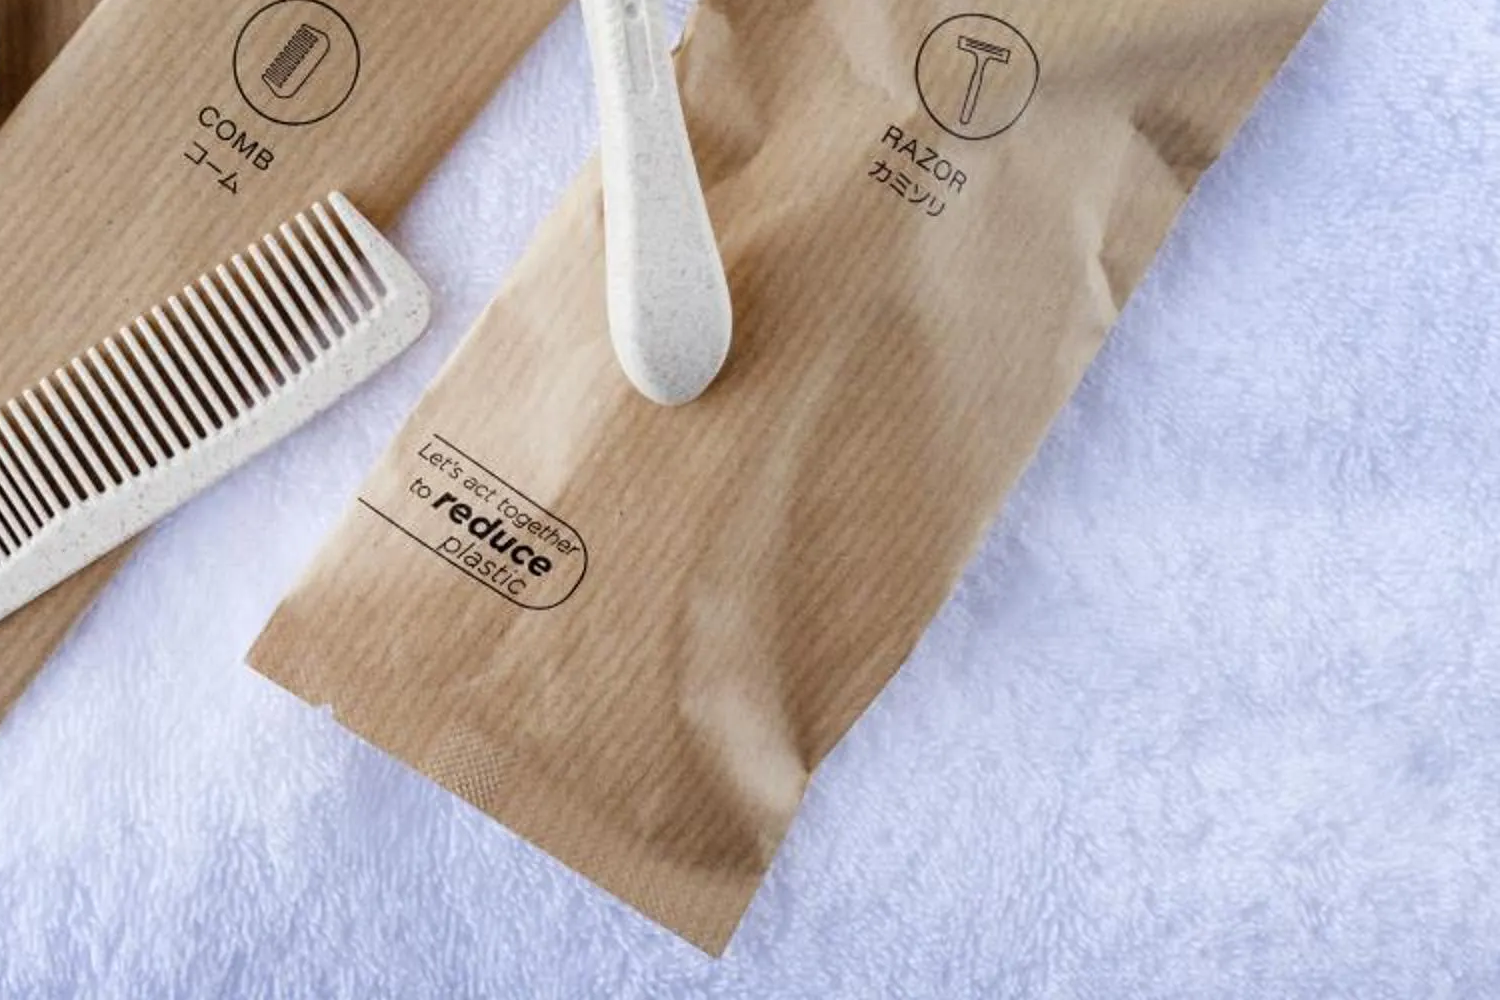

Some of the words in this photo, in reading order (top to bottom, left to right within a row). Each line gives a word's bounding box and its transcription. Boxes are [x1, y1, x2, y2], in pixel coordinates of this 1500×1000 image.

[184, 141, 238, 194] コーム
[198, 105, 275, 171] COMB
[881, 124, 968, 193] RAZOR
[868, 160, 945, 217] カミソリ
[408, 476, 432, 499] to
[431, 491, 553, 577] reduce
[417, 442, 463, 480] Let's
[463, 477, 497, 502] act
[497, 497, 581, 556] together
[437, 535, 527, 596] plastic
